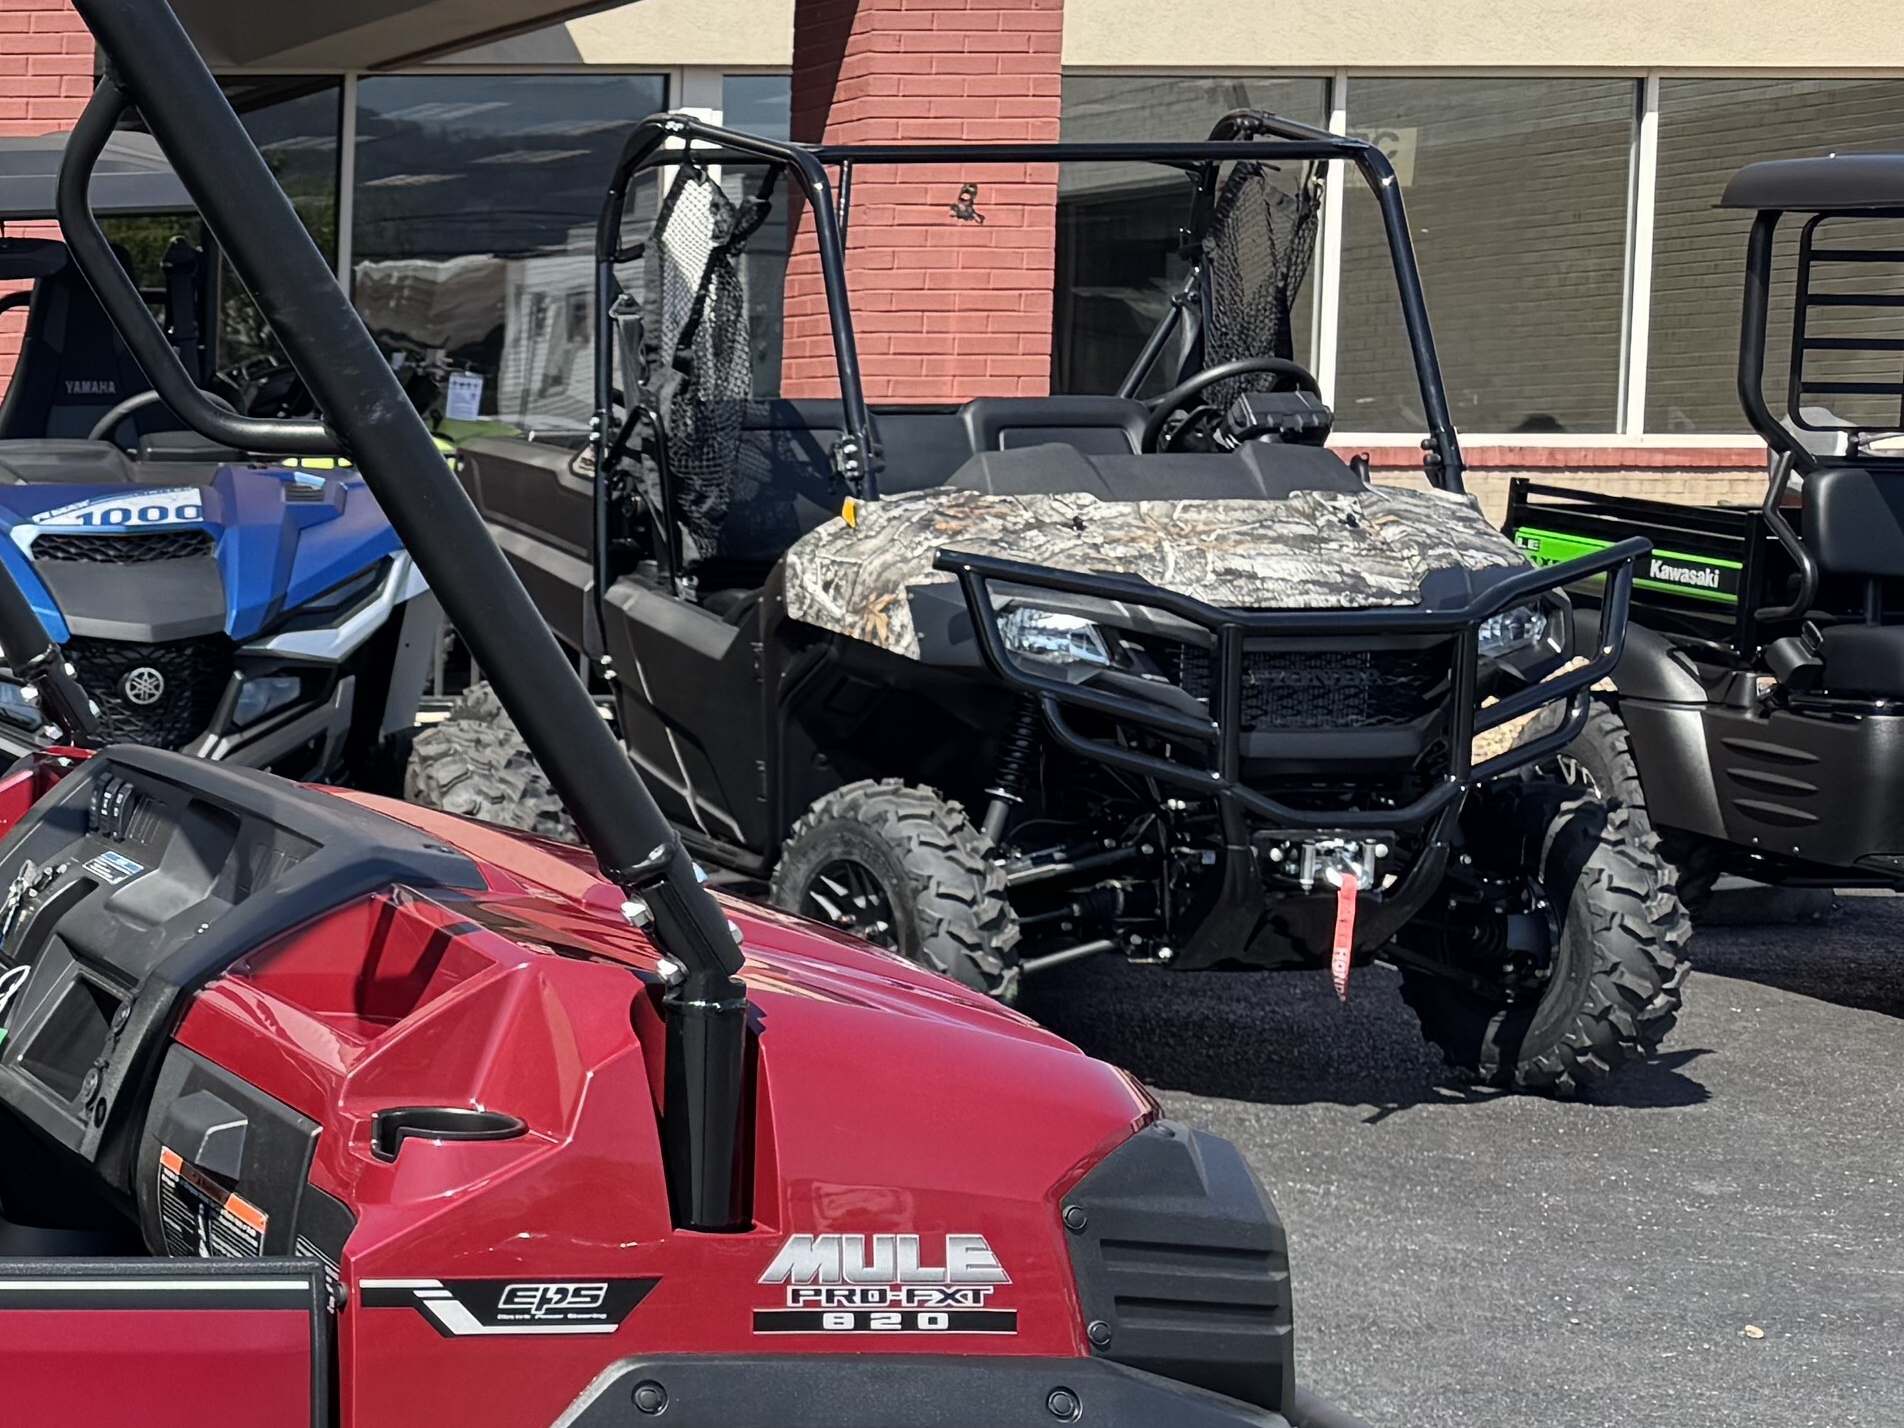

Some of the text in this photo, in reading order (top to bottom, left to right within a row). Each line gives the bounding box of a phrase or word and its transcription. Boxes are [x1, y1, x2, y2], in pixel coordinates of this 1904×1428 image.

[64, 379, 116, 395] YAMAHA
[76, 504, 204, 525] 1000
[1649, 559, 1720, 589] Kawasaki
[758, 1233, 1013, 1284] MULE
[787, 1285, 994, 1307] PRO-FXT
